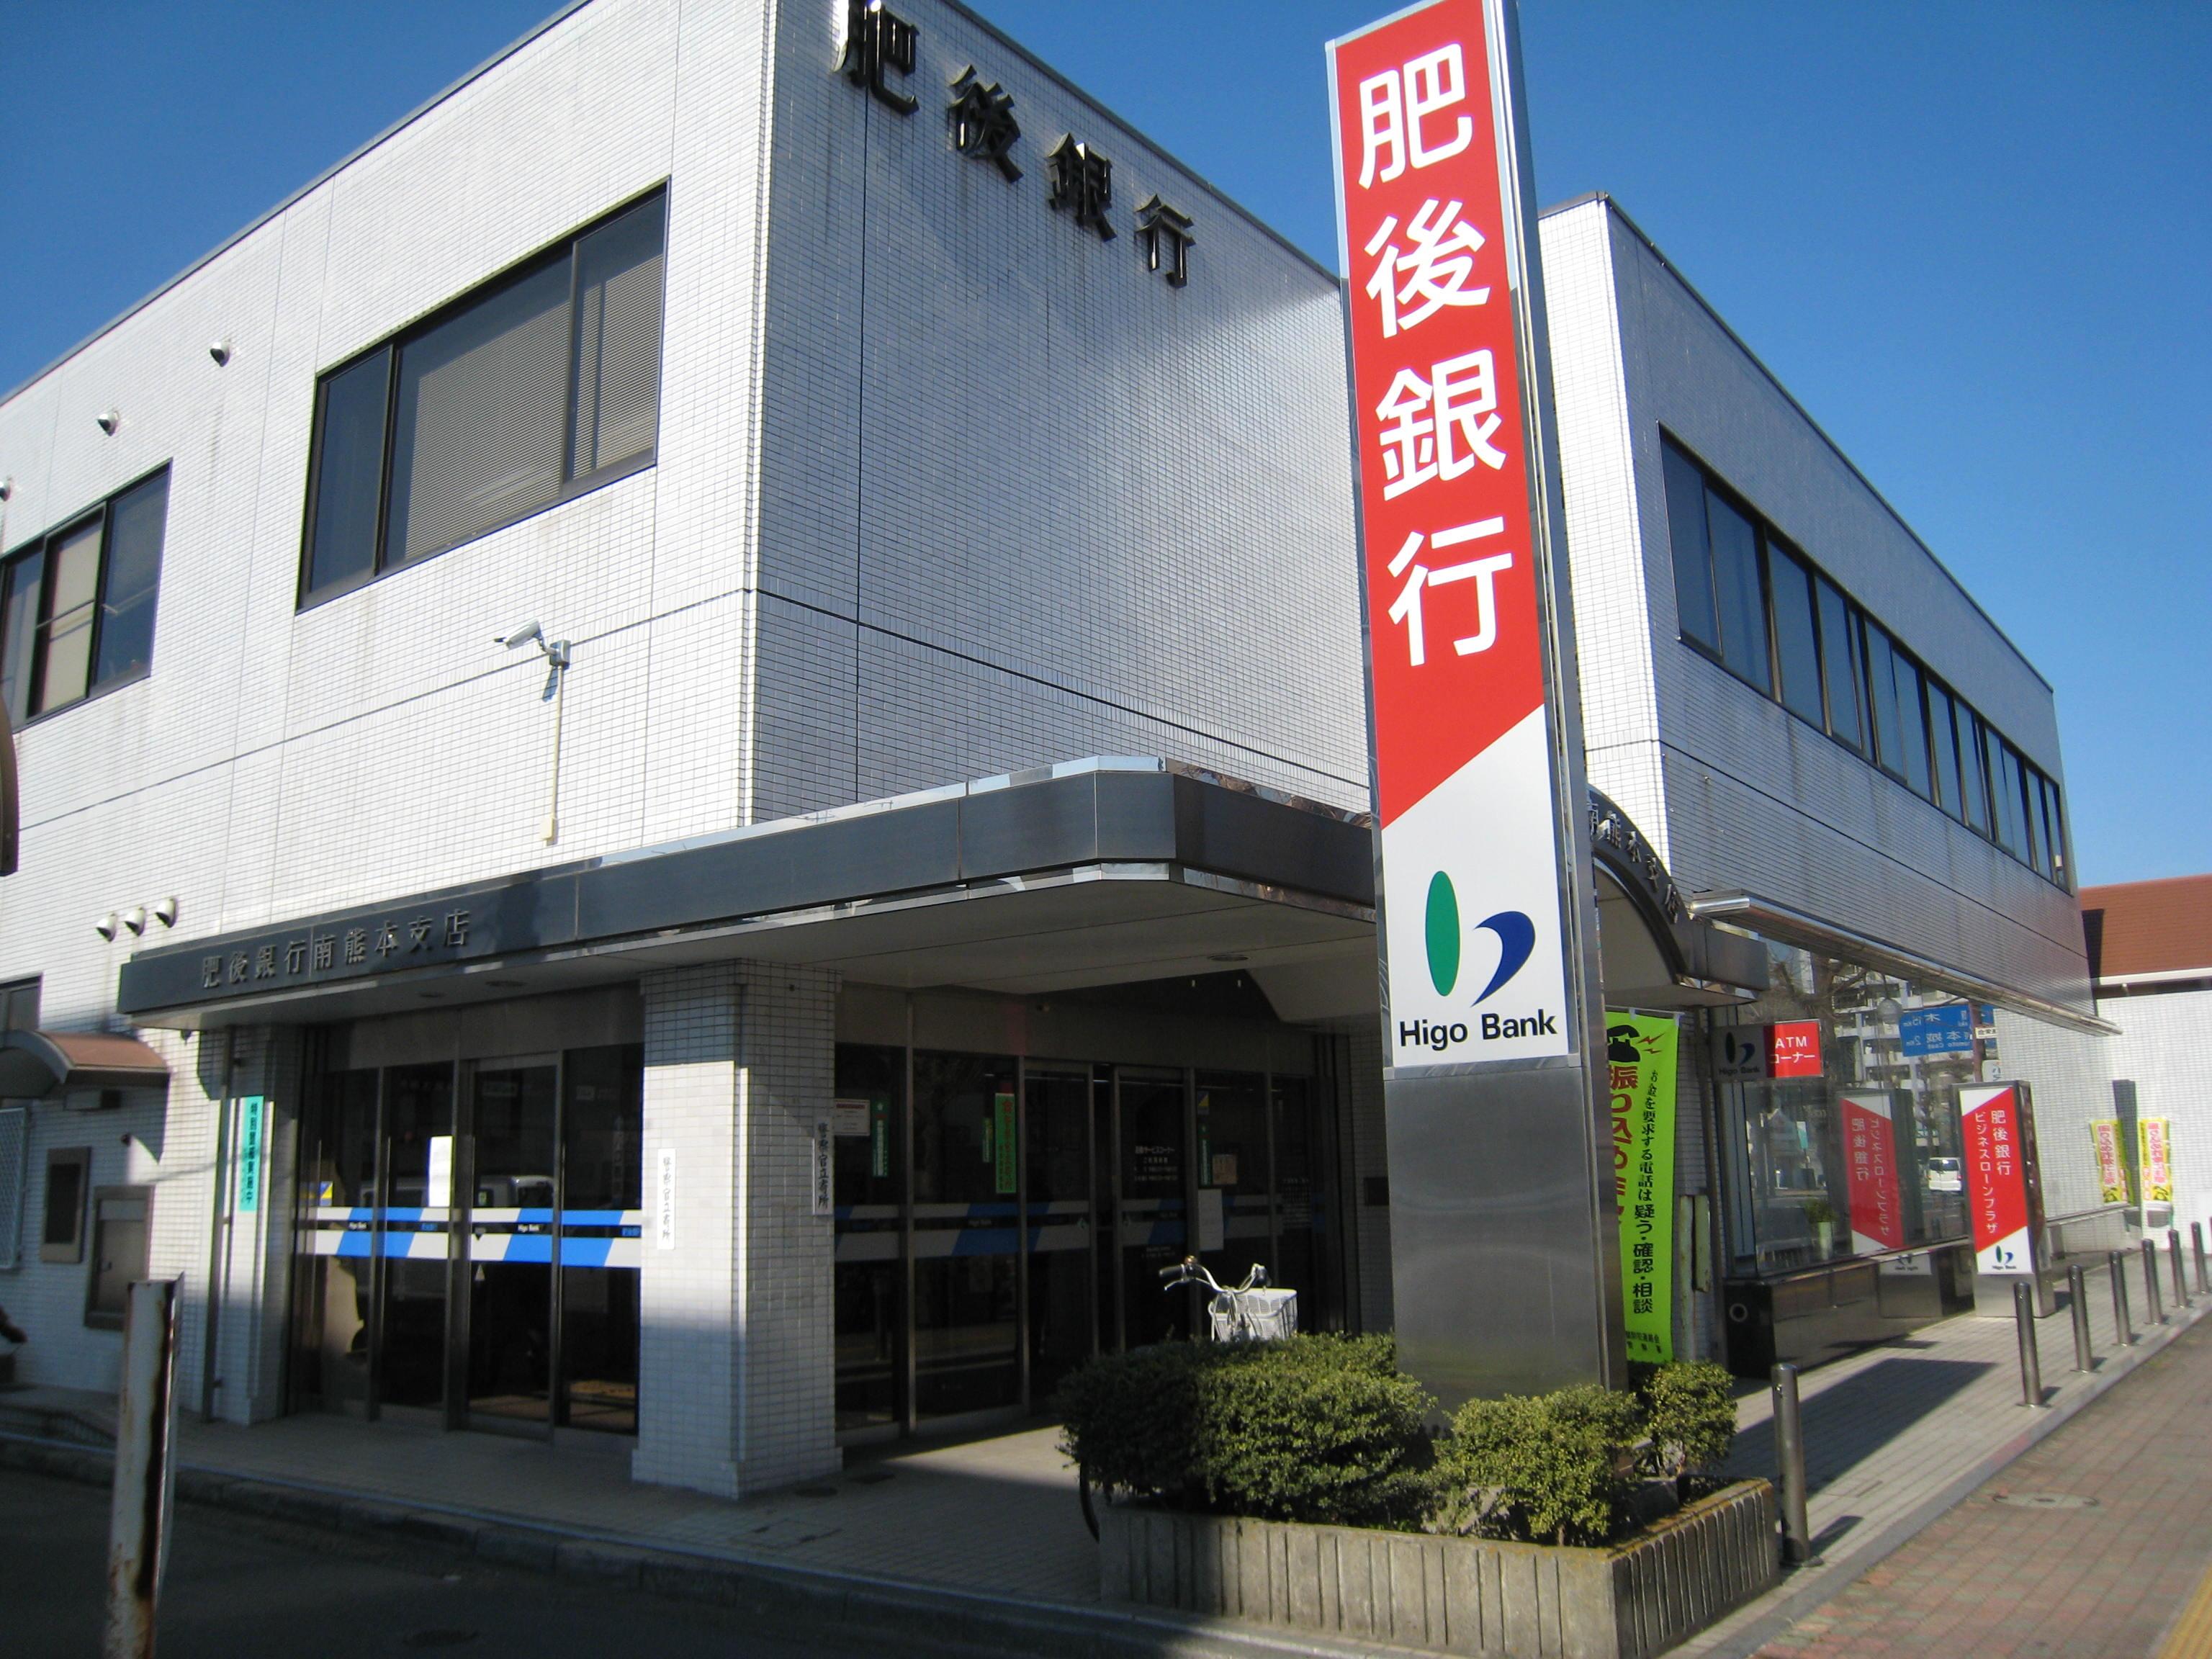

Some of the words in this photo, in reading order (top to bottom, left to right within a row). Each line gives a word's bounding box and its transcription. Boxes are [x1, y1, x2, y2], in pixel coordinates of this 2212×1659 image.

[832, 0, 1196, 287] 肥後銀行
[1357, 41, 1513, 667] 肥後銀行
[202, 908, 470, 988] 肥後銀行南熊本支店
[1399, 1017, 1468, 1051] Higo
[1480, 1008, 1558, 1040] Bank
[1769, 1051, 1815, 1064] コーナー
[1775, 1035, 1807, 1049] ATM
[1975, 1111, 1998, 1234] ビジネスローンプラザ
[1991, 1110, 2012, 1176] 肥後銀行
